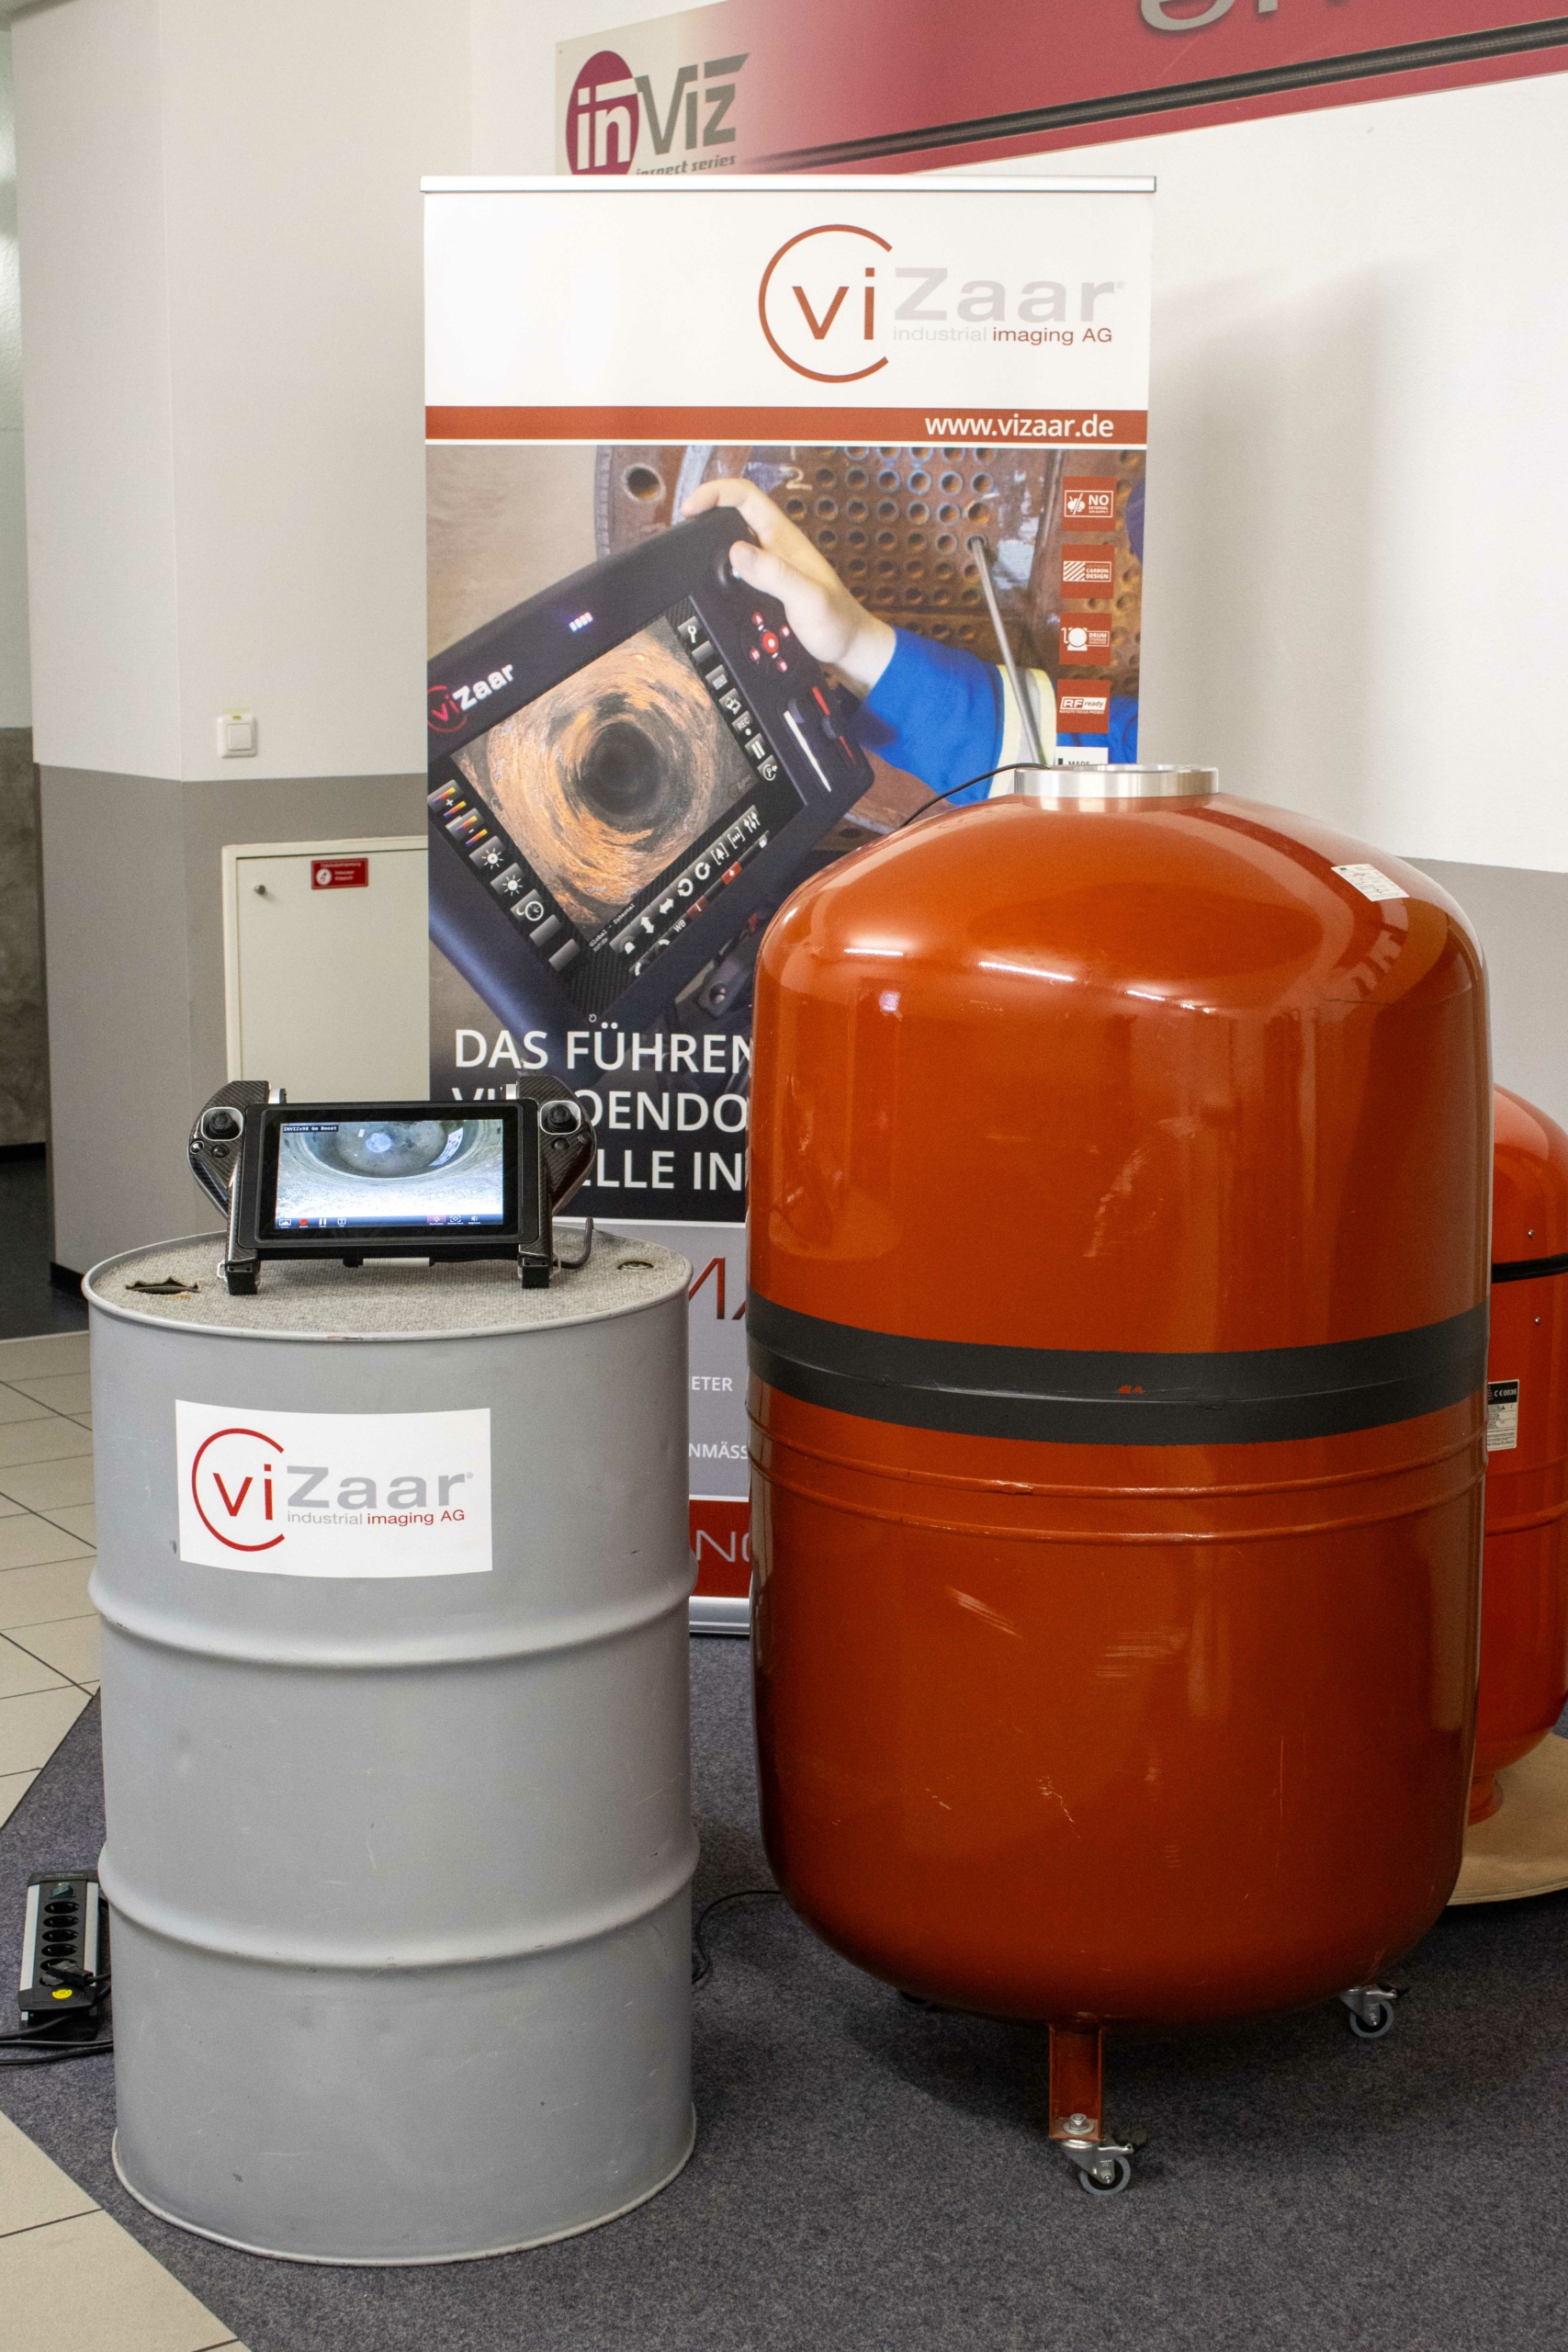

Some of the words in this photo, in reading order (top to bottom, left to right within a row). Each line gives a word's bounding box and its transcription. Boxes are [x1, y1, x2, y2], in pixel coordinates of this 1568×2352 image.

[691, 154, 737, 171] series
[893, 326, 987, 342] industrial
[992, 327, 1074, 346] imaging
[1082, 328, 1113, 343] AG
[925, 413, 1114, 437] www.vizaar.de
[1088, 494, 1110, 506] NO
[737, 716, 750, 731] REC
[455, 1029, 548, 1069] DAS
[582, 1149, 675, 1189] LLE
[694, 1151, 742, 1191] IN
[288, 1510, 363, 1525] industrial
[367, 1512, 434, 1527] imaging
[440, 1510, 465, 1521] AG
